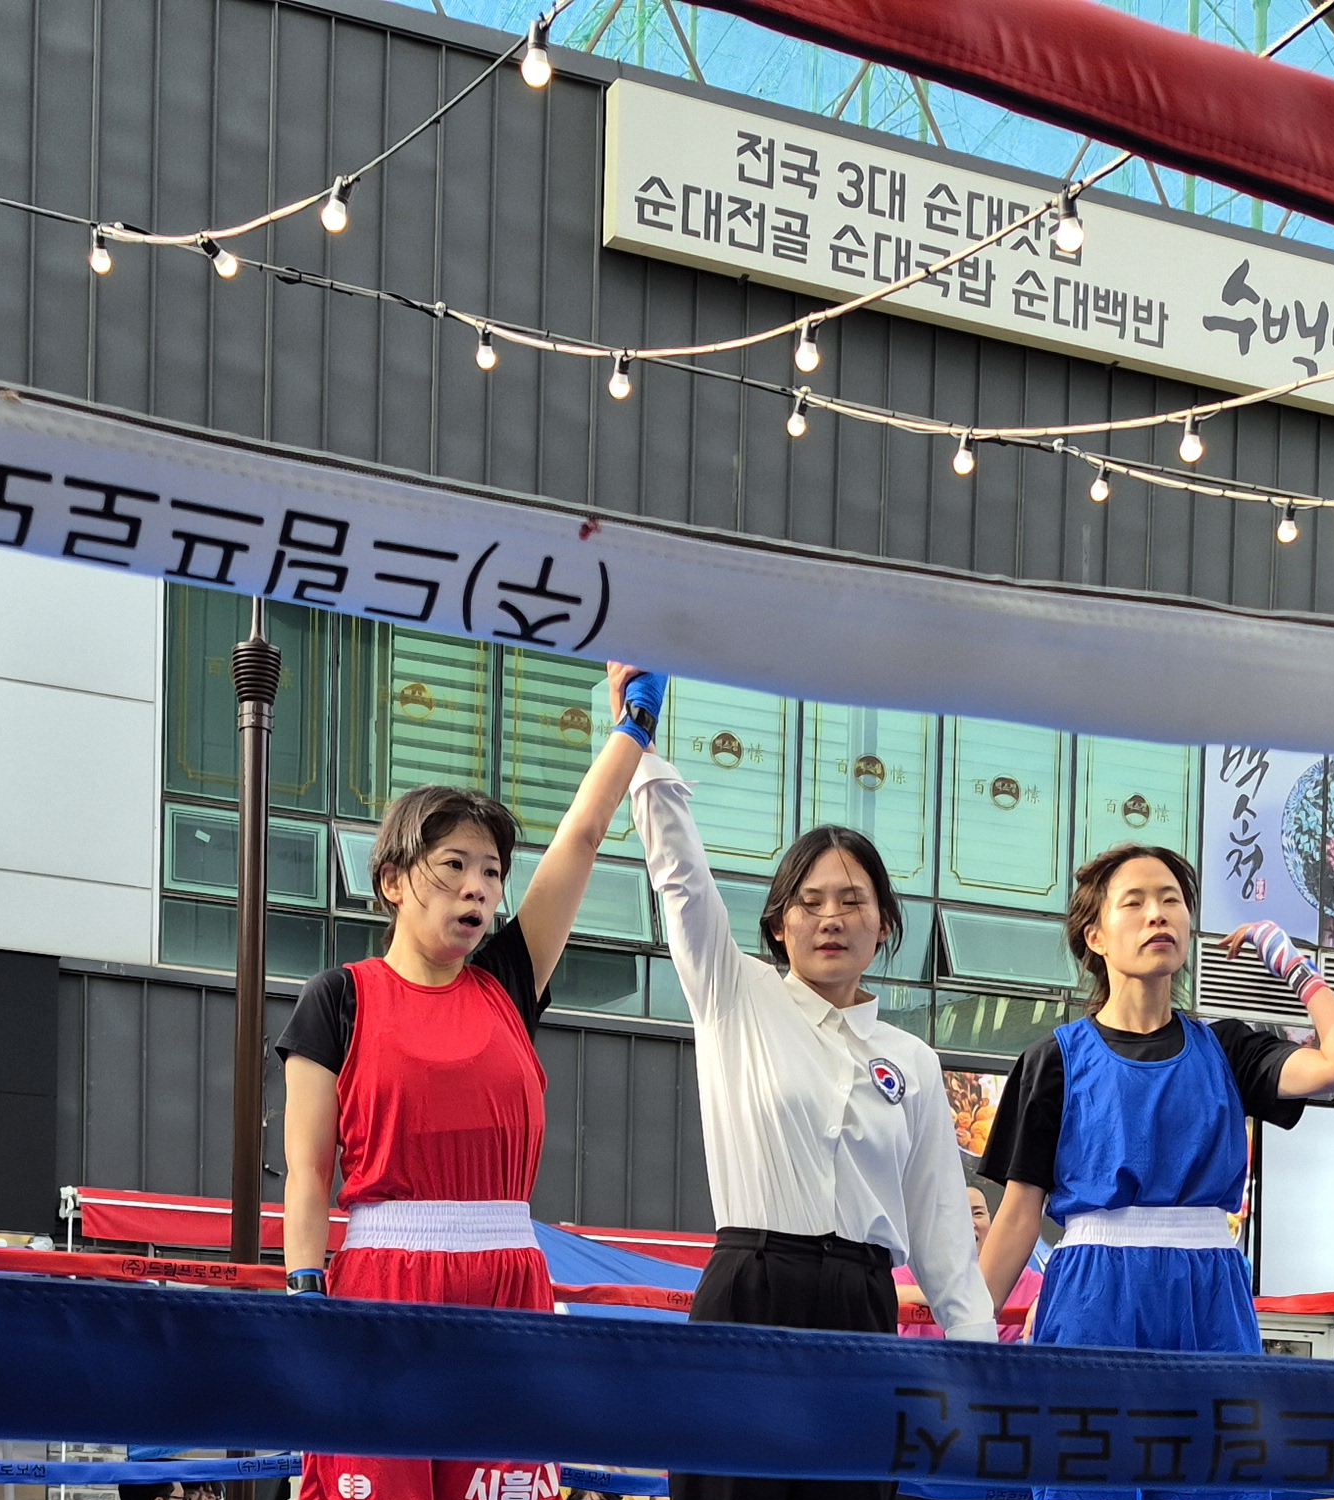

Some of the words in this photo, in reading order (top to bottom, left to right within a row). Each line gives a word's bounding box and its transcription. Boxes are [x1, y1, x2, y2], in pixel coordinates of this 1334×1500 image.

[736, 130, 820, 200] 전국
[837, 161, 906, 222] 3대
[635, 175, 810, 264] 순대전골
[830, 224, 996, 308] 순대국밥
[1011, 268, 1169, 349] 순대백반
